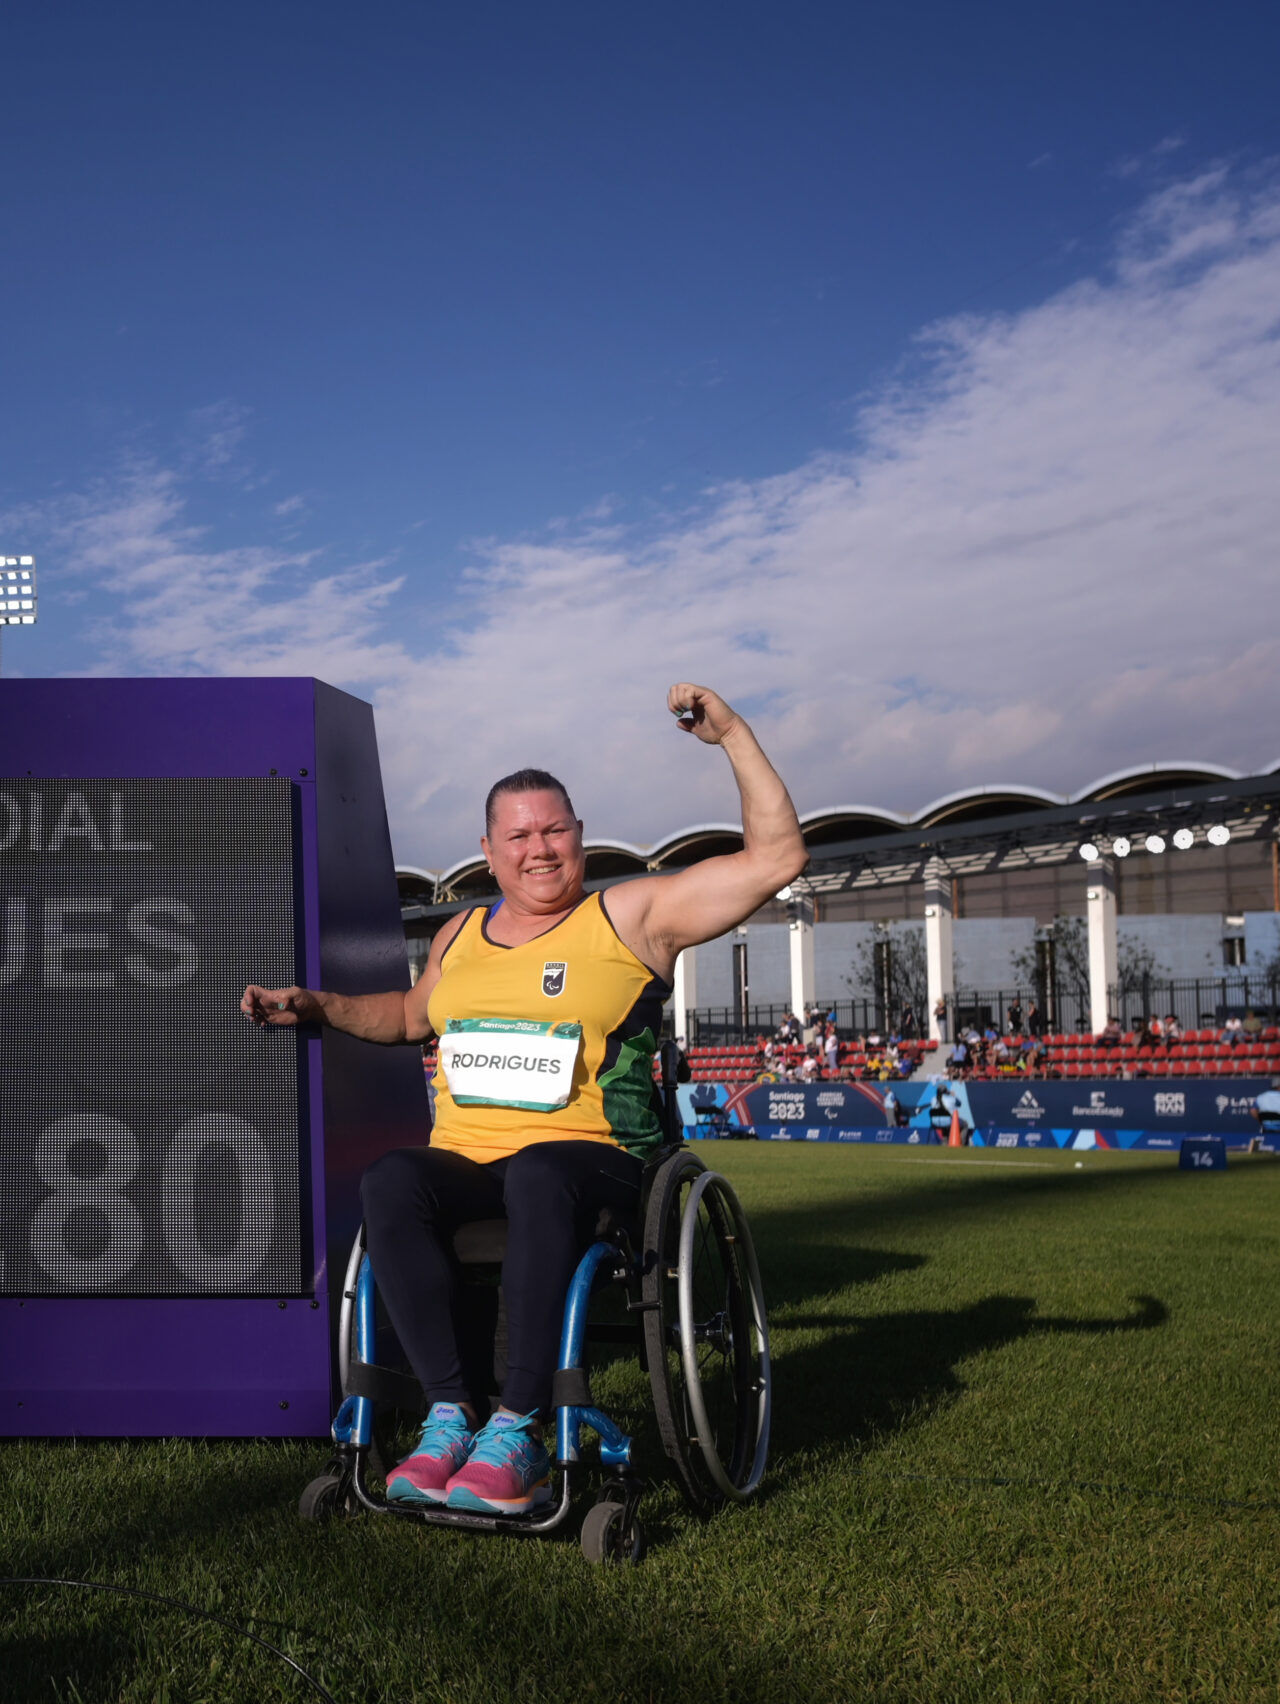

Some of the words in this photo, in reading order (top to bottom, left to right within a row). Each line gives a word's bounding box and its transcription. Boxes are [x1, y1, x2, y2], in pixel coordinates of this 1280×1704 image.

[451, 1053, 561, 1074] RODRIGUES
[768, 1090, 805, 1102] Santiago
[1230, 1097, 1257, 1107] LAT
[768, 1102, 805, 1120] 2023
[1191, 1151, 1214, 1167] 14
